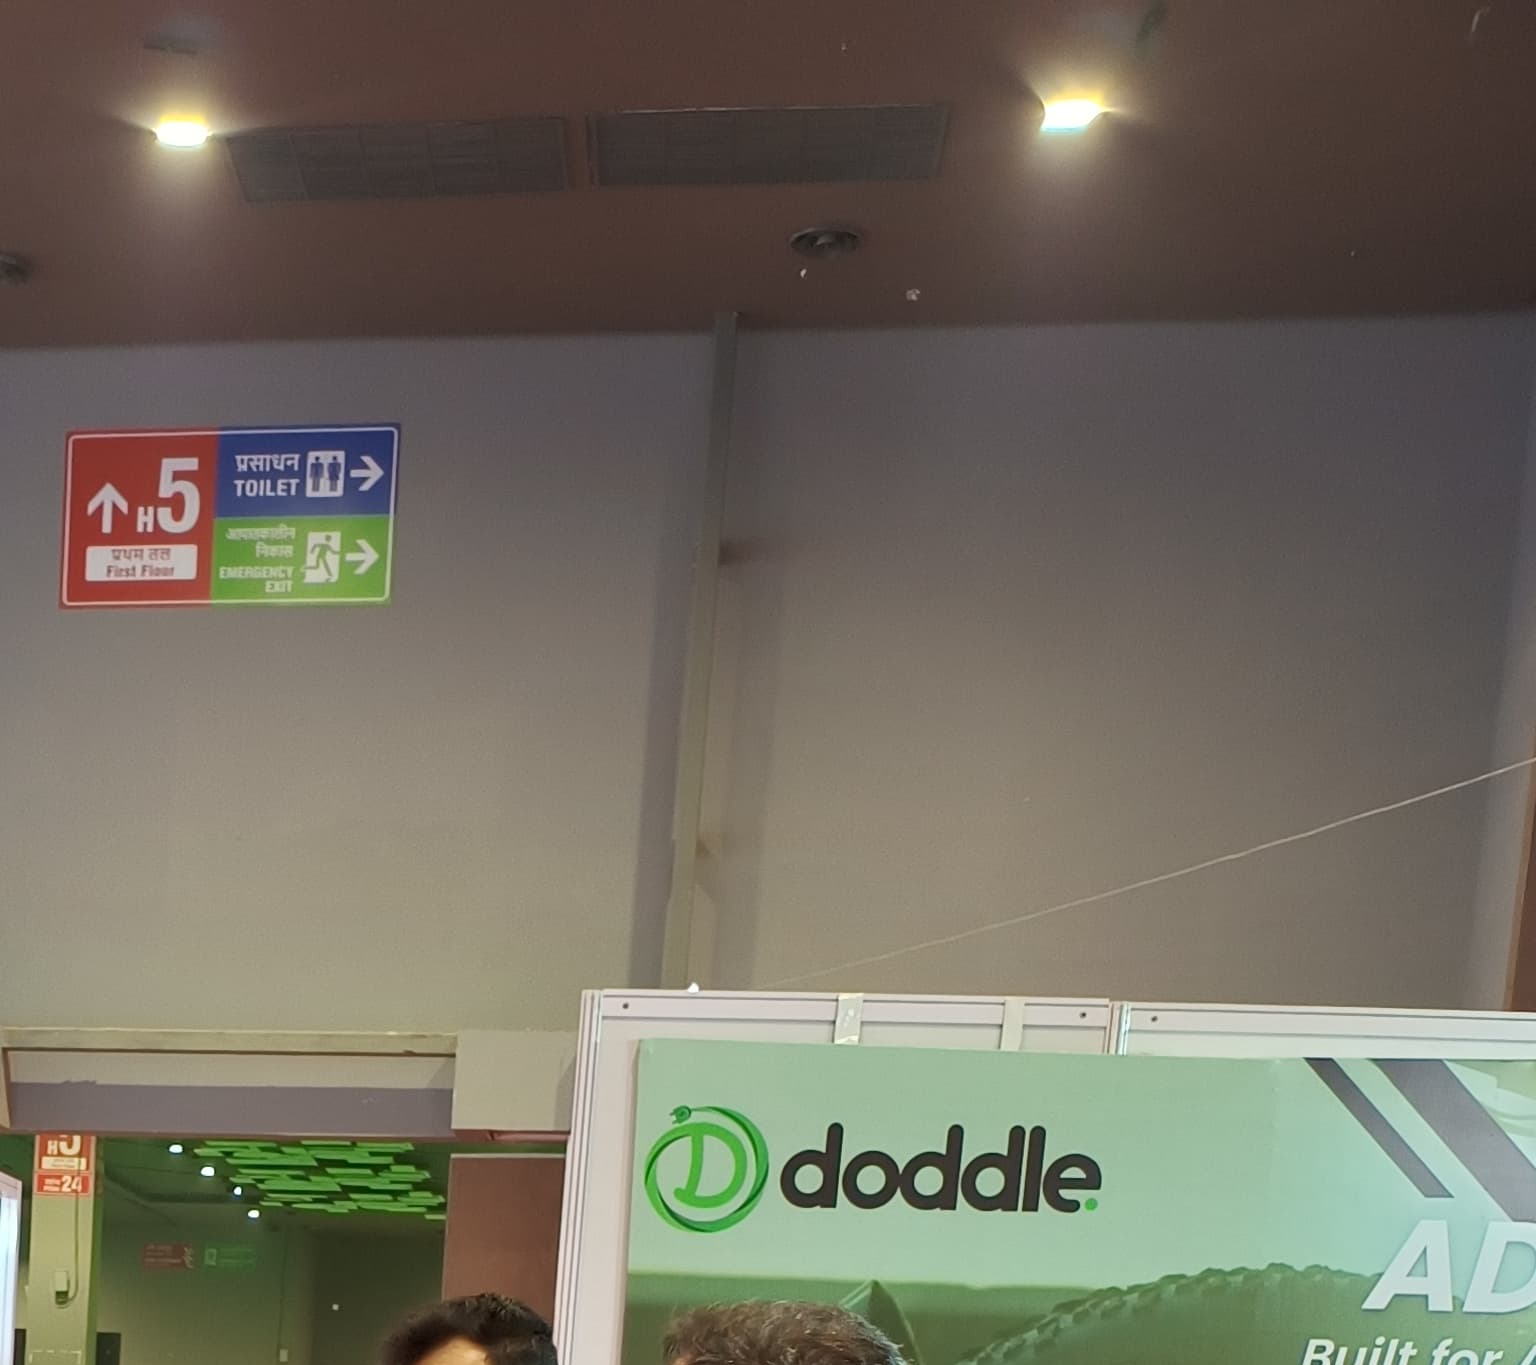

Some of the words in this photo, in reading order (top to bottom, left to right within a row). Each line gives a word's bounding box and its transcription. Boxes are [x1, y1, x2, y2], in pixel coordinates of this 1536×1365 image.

[234, 454, 300, 472] प्रसाधन
[233, 479, 300, 497] TOILET
[106, 565, 137, 578] First
[141, 564, 175, 577] Floor
[61, 1176, 82, 1192] 24
